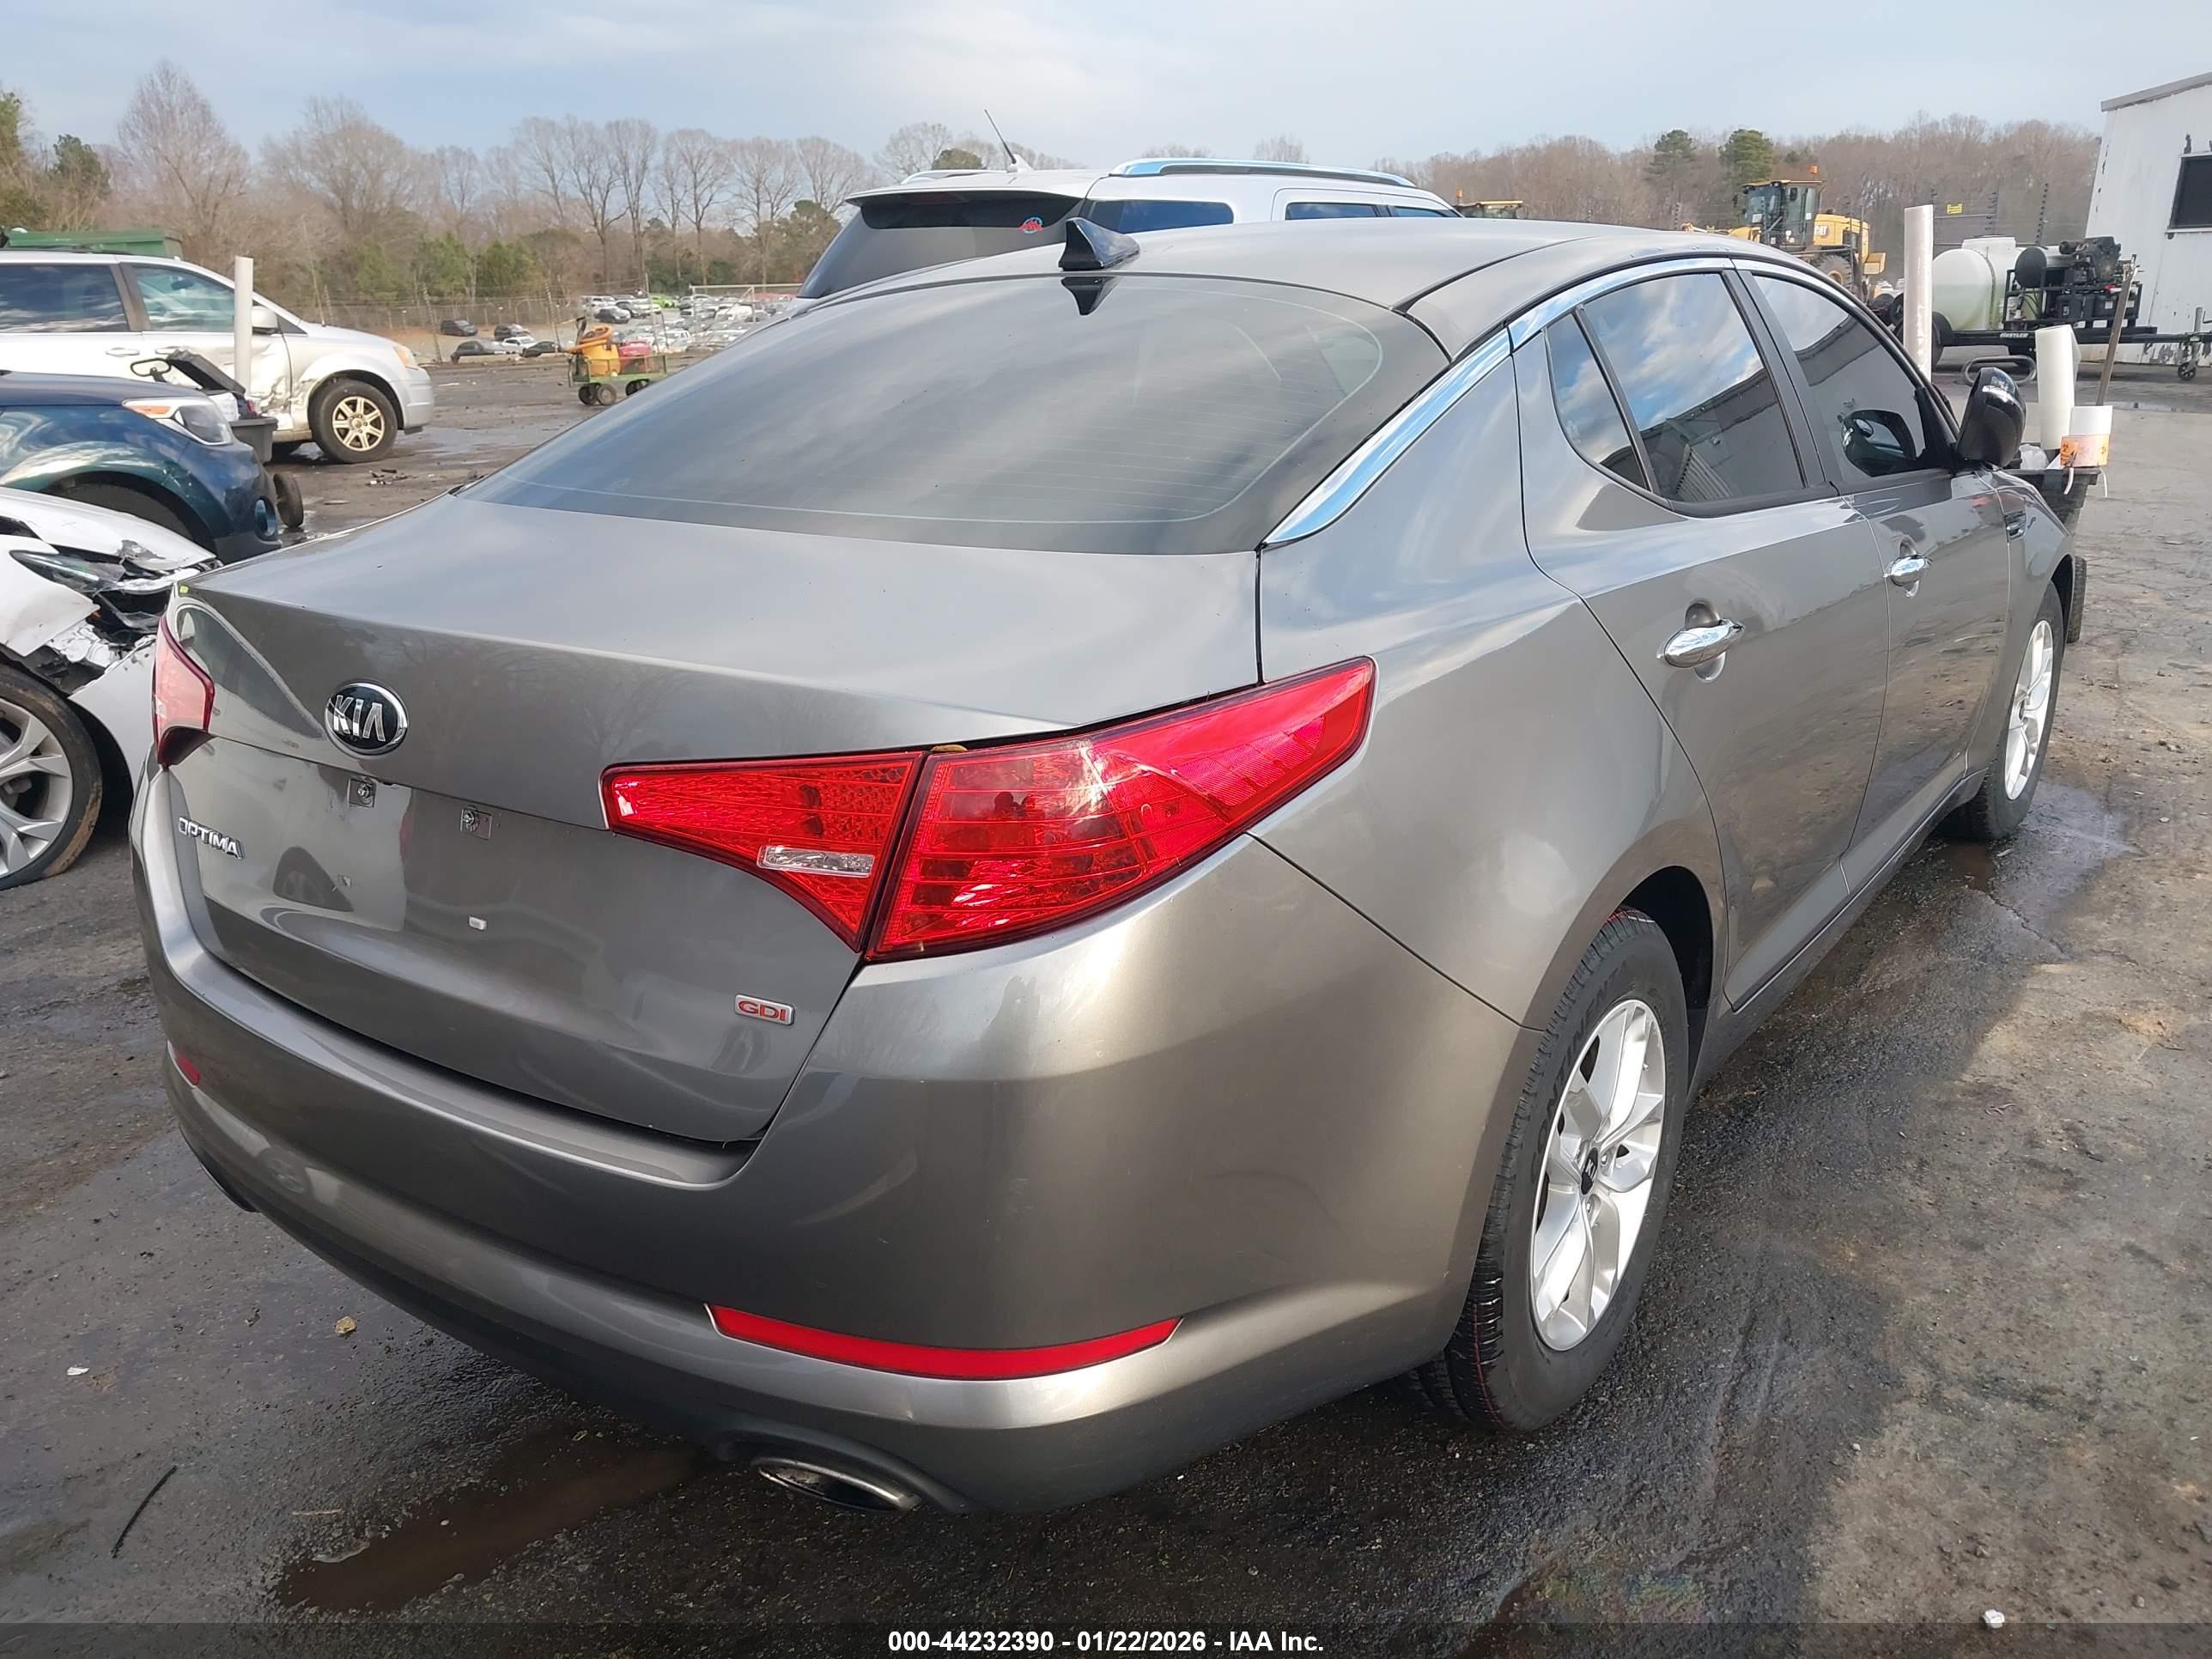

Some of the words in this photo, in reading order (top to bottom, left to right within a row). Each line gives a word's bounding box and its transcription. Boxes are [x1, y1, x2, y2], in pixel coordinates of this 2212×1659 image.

[1814, 225, 1828, 236] CAT
[333, 694, 386, 742] KIA
[179, 817, 244, 860] OPTIMA
[738, 1000, 787, 1022] GDI
[1530, 955, 1633, 1184] CONTINENT
